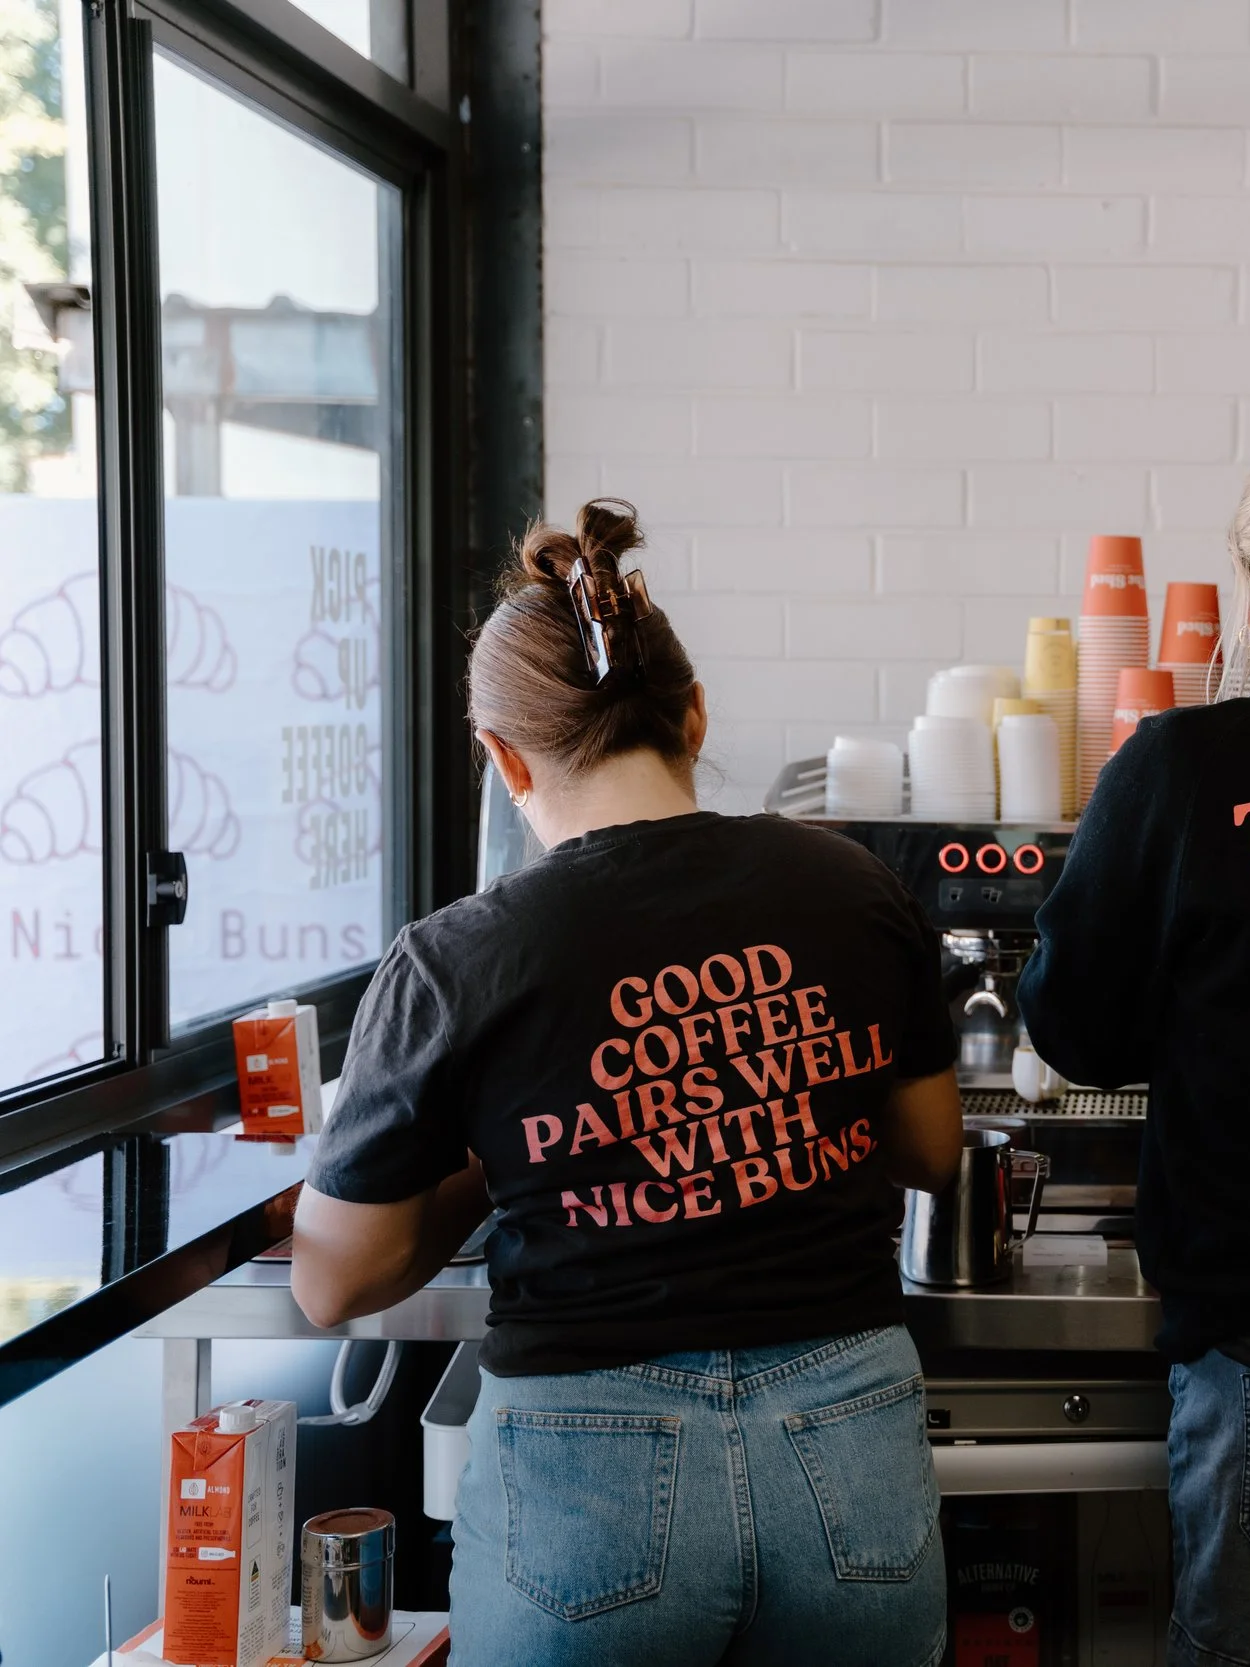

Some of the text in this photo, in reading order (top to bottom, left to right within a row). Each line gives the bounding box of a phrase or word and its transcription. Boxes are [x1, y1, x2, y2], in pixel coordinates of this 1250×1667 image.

[11, 909, 368, 962] Ni Buns
[610, 944, 792, 1028] GOOD
[590, 985, 836, 1090] COFFEE
[521, 1024, 893, 1163] PAIRS WELL
[631, 1091, 819, 1178] WITH
[561, 1118, 878, 1227] NICE BUNS.
[207, 1485, 230, 1495] ALMOND
[957, 1562, 1041, 1587] ALTERNATIVE
